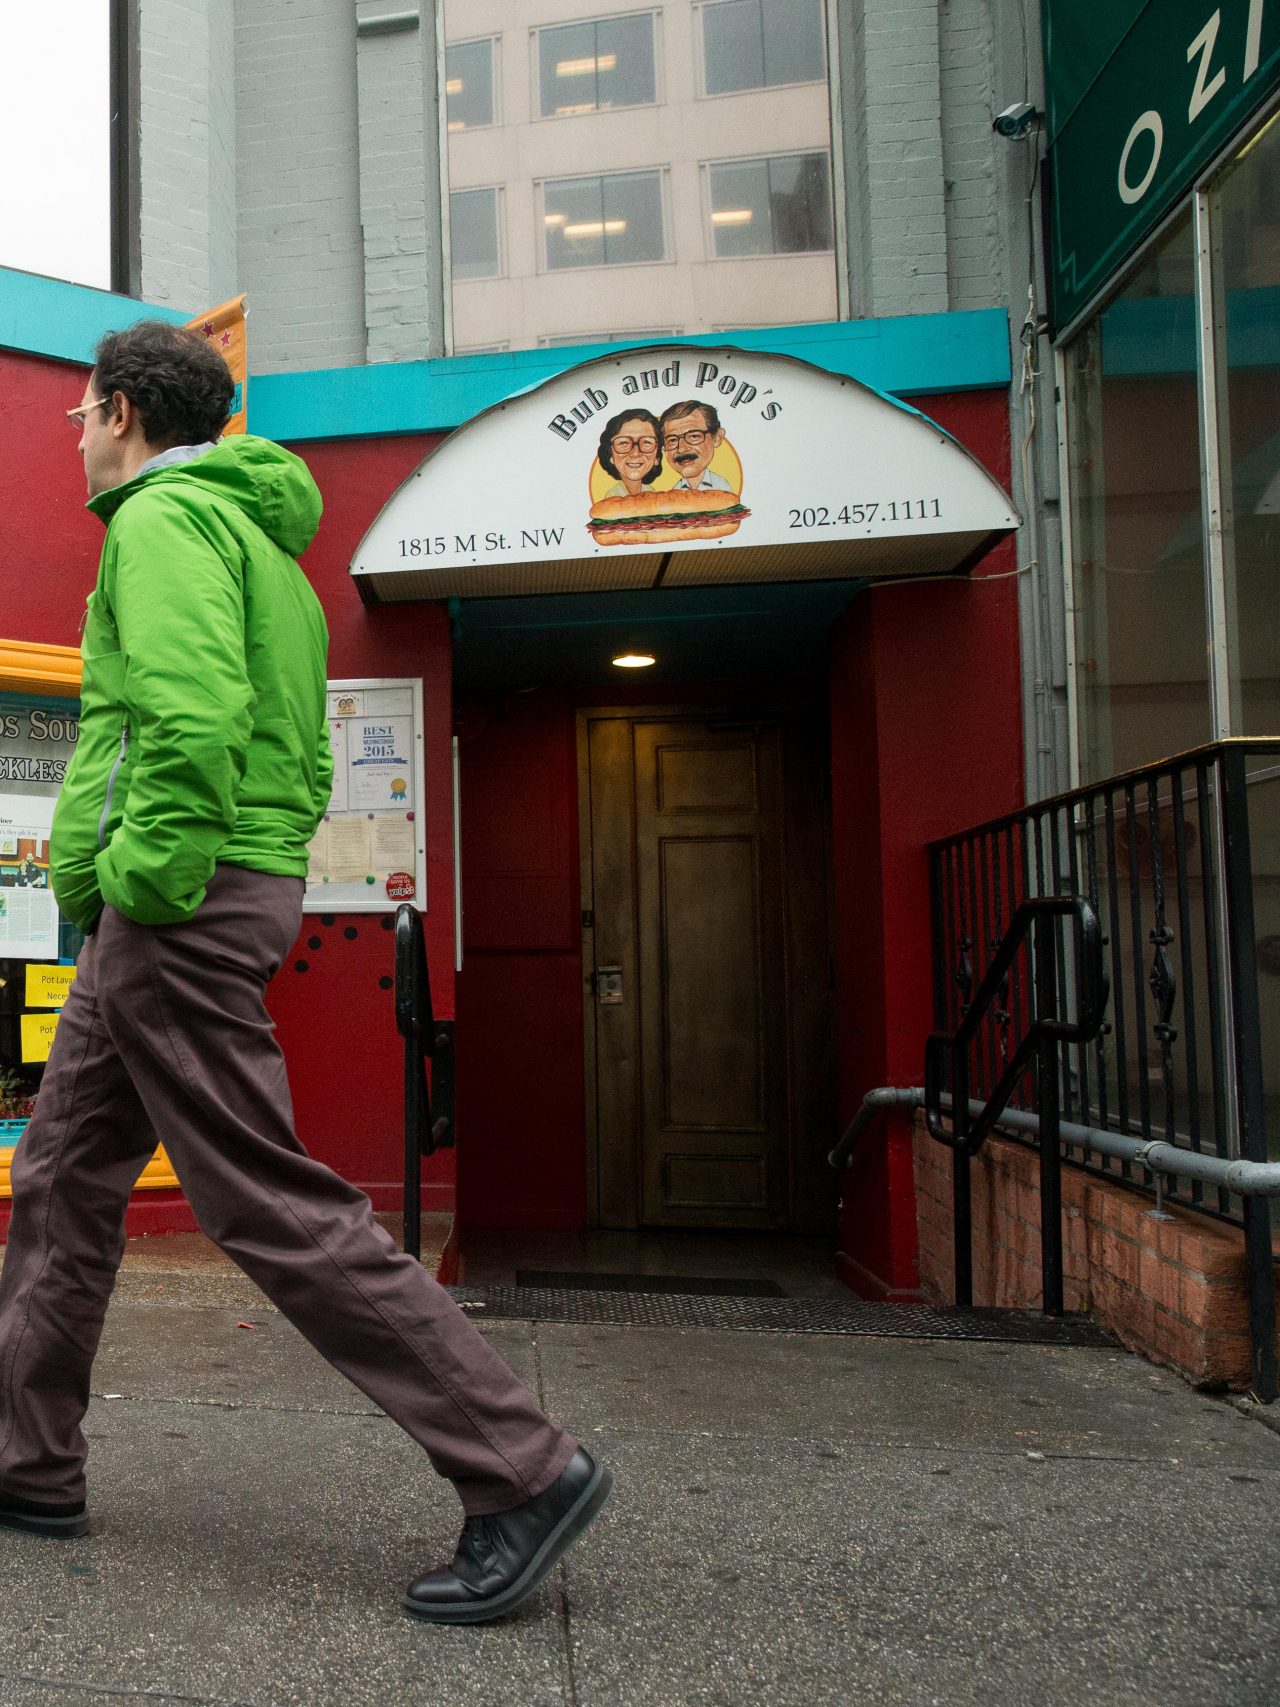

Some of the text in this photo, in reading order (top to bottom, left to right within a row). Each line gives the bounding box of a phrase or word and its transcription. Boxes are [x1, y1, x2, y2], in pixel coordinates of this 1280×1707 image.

[547, 360, 783, 442] Bub and Pop's
[788, 498, 943, 529] 202.457.1111
[398, 527, 566, 557] 1815 M St. NW
[363, 726, 394, 736] BEST
[364, 746, 395, 757] 2015
[42, 976, 55, 984] Pot
[40, 1026, 53, 1034] Pot
